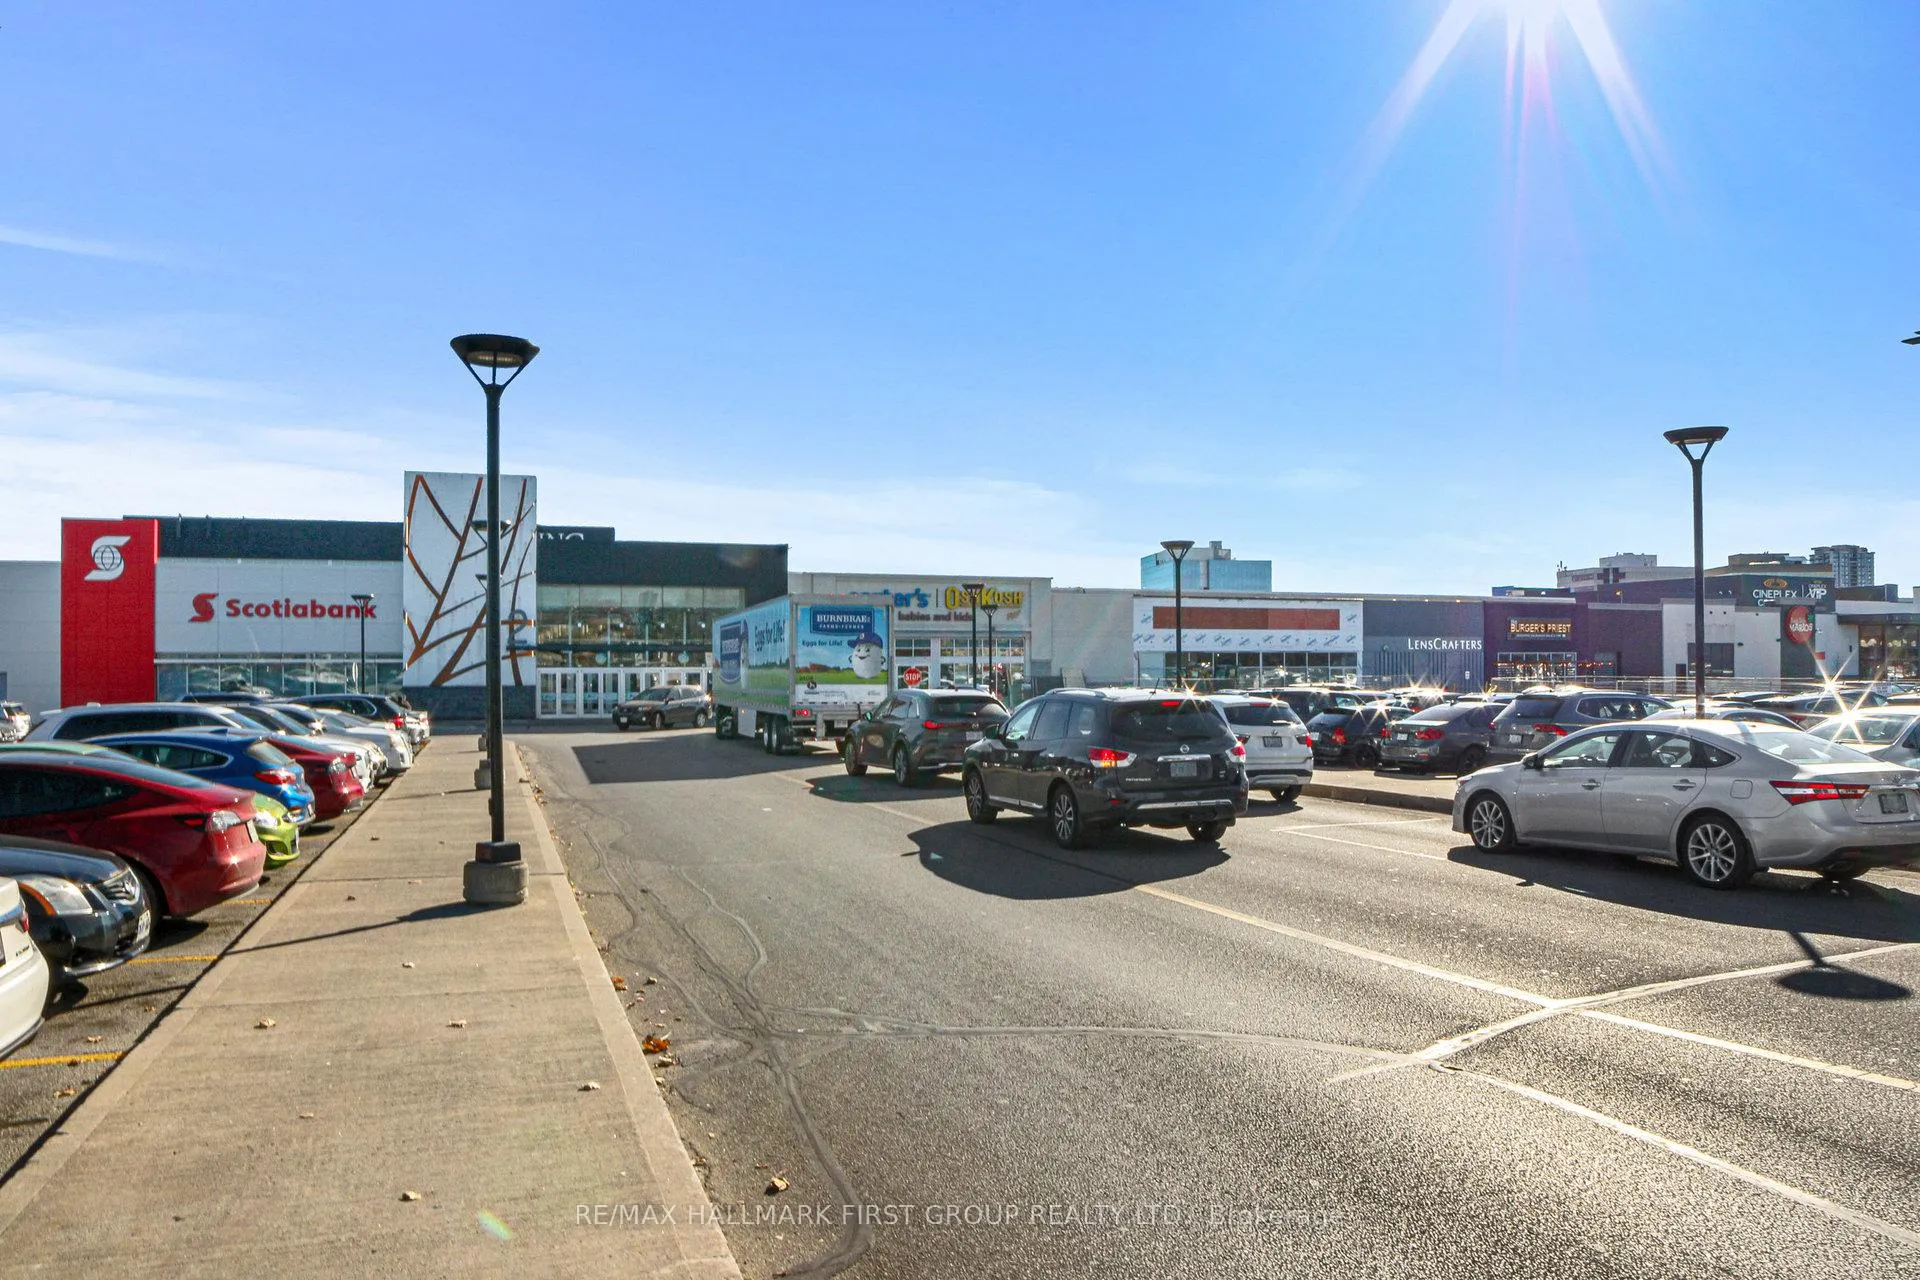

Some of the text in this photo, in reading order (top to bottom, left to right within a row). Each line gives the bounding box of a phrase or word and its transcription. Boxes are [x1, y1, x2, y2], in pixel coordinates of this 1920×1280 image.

[226, 599, 377, 619] Scotiabank
[933, 612, 951, 620] and
[1511, 623, 1571, 633] BURGER'S PRIEST
[905, 673, 920, 681] STOP
